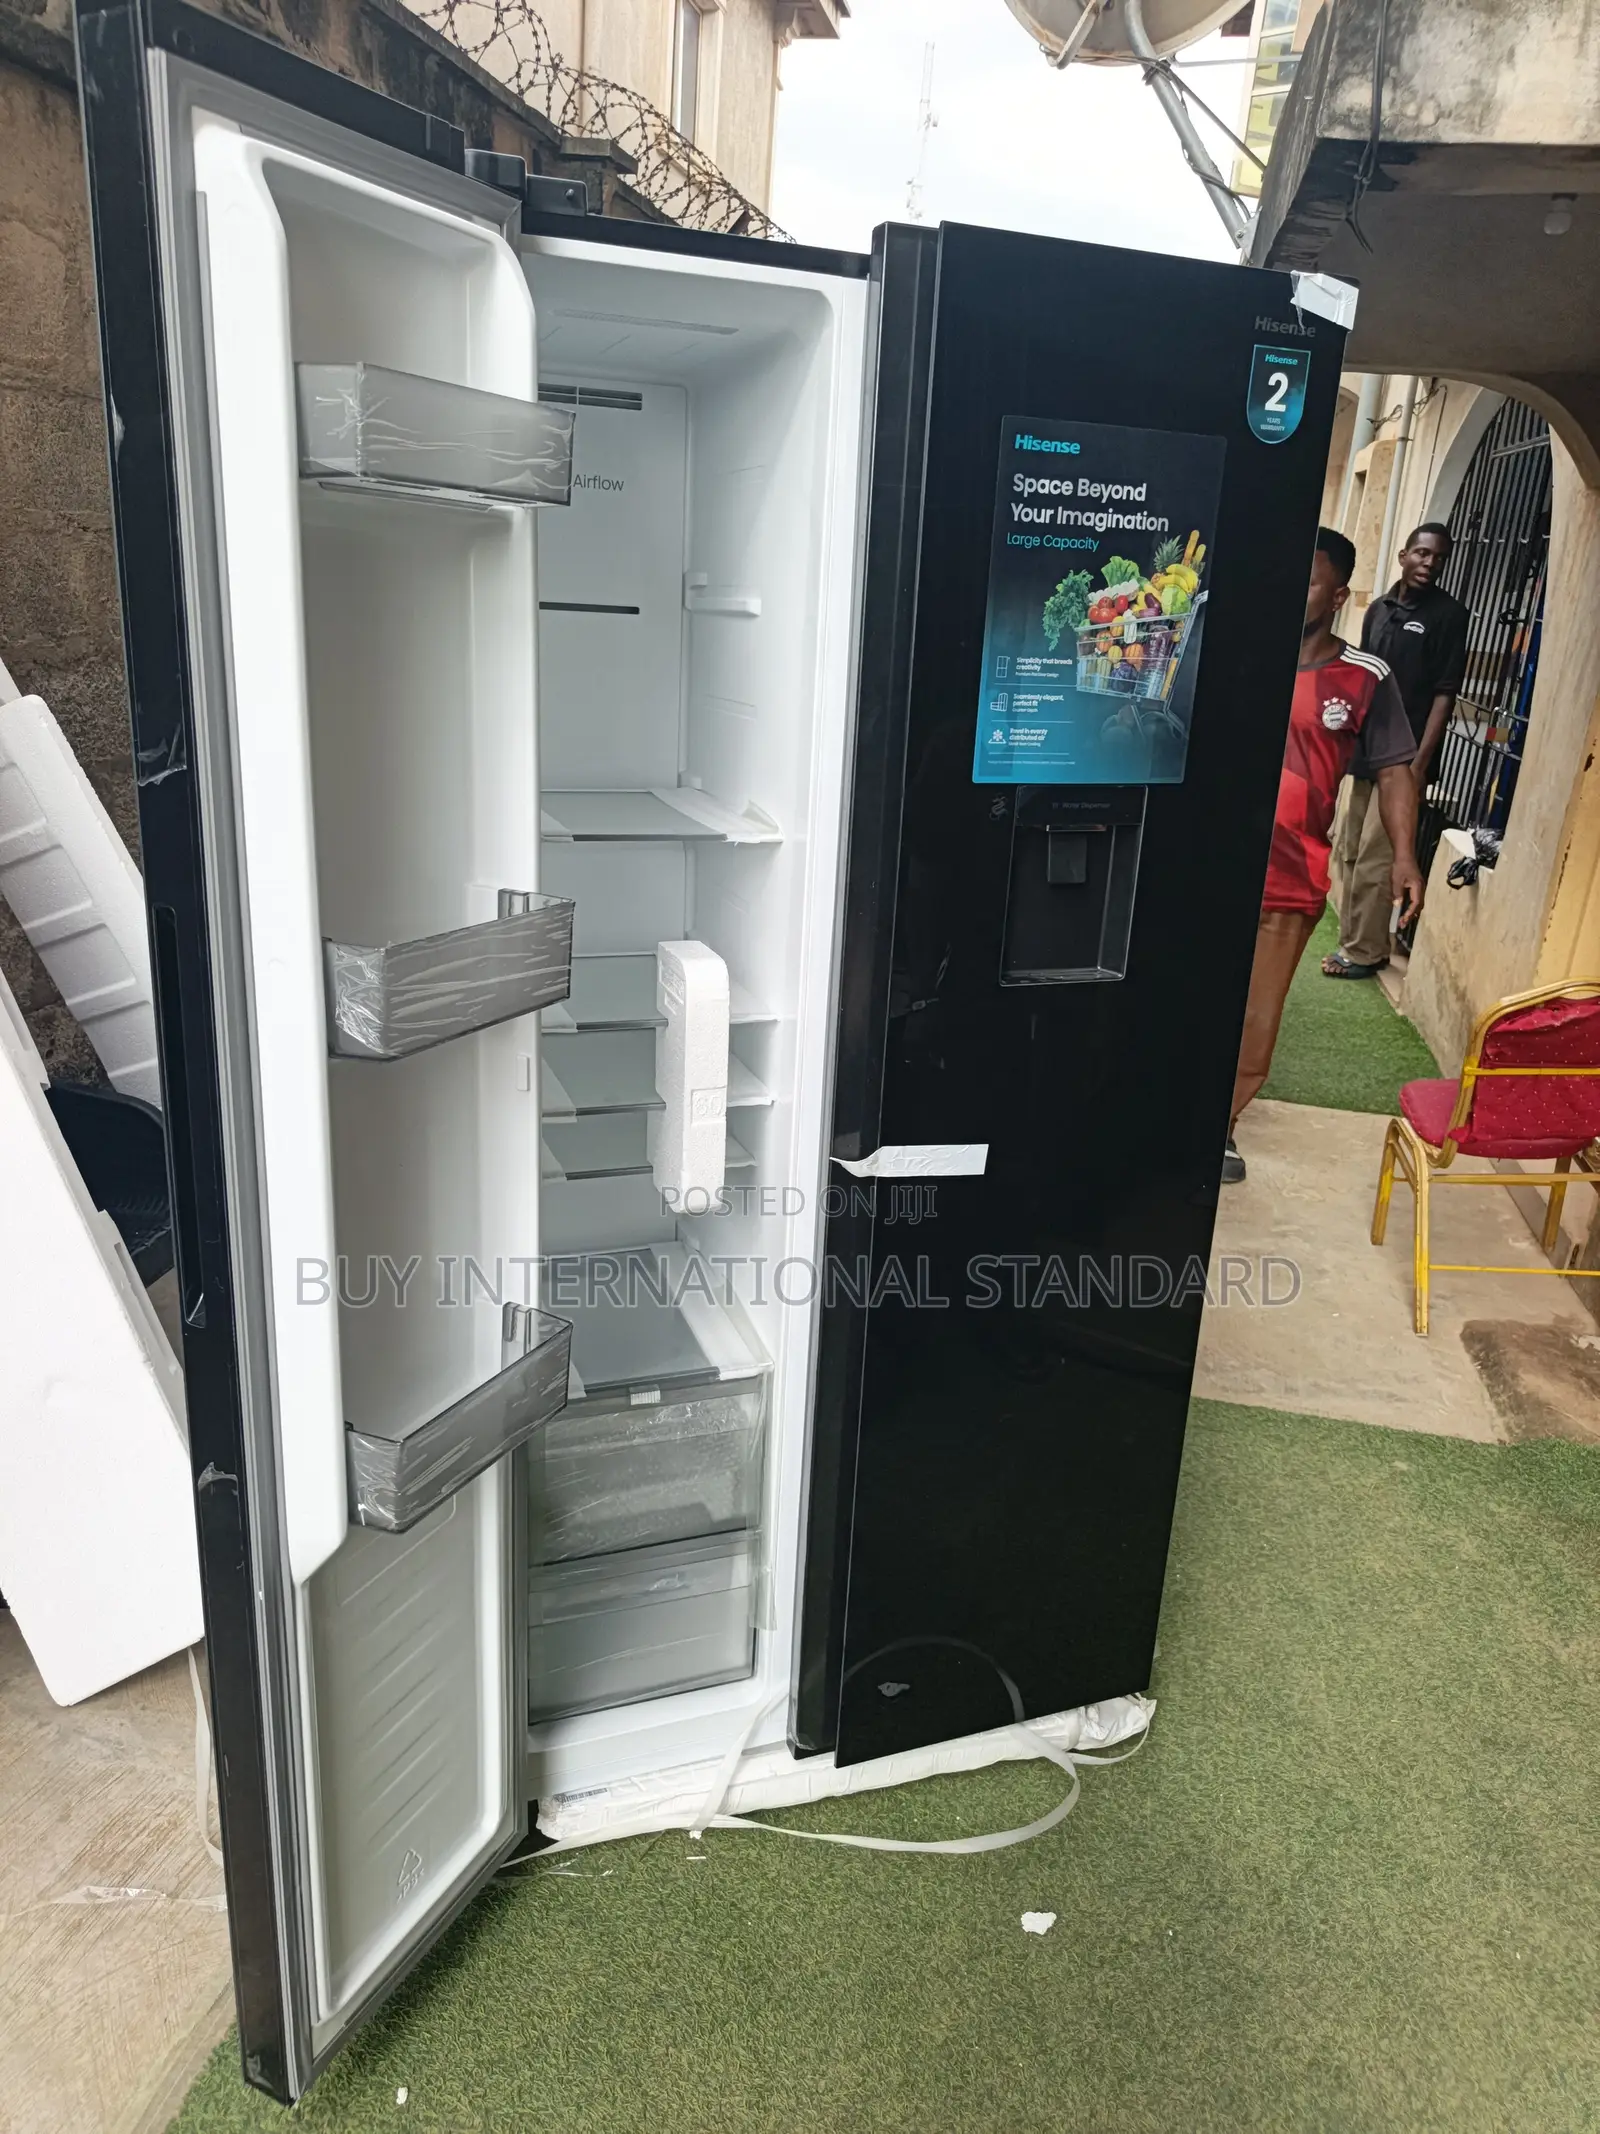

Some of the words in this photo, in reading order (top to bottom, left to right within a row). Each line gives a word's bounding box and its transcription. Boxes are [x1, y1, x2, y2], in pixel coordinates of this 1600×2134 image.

[1254, 315, 1316, 338] Hisense
[1265, 354, 1298, 365] Hisense
[1264, 372, 1289, 412] 2
[1015, 434, 1080, 454] Hisense
[573, 474, 624, 491] Airflow
[1013, 473, 1074, 498] Space
[1077, 478, 1147, 503] Beyond
[1011, 503, 1054, 524] Your
[1057, 506, 1169, 532] Imagination
[1007, 532, 1041, 549] Large
[1043, 534, 1099, 552] Capacity
